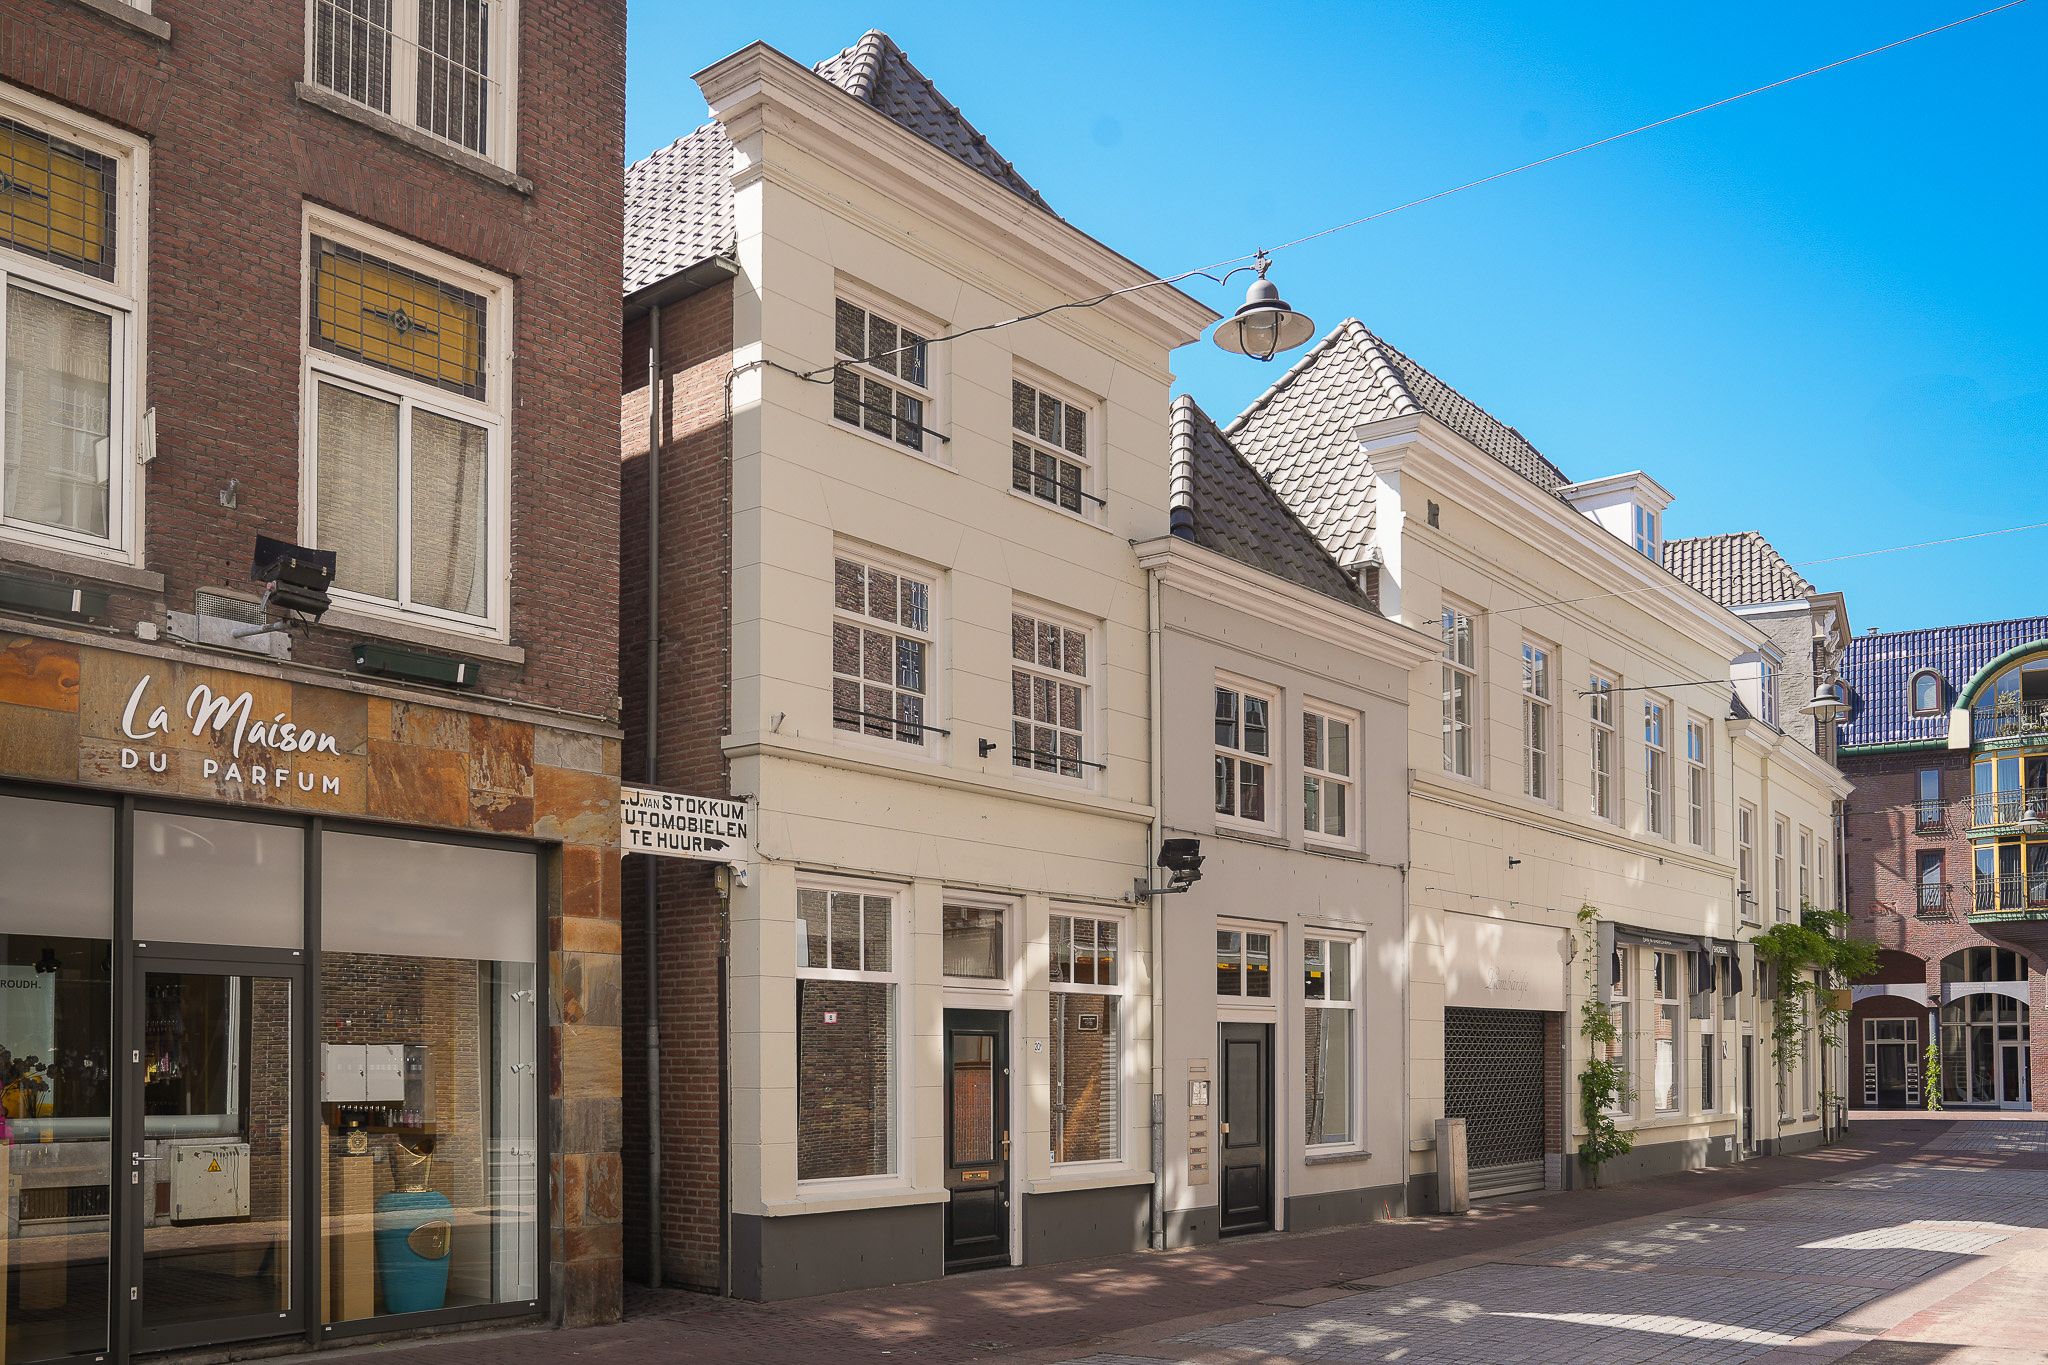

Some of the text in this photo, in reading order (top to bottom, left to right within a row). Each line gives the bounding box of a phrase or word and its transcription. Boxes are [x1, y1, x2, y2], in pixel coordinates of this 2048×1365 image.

[121, 674, 341, 759] La Maison
[121, 748, 340, 796] DU PARFUM
[643, 797, 660, 810] VAN
[662, 794, 744, 820] STOKKUM
[621, 808, 747, 839] UTOMOBIELEN
[630, 829, 702, 853] TE HUUR
